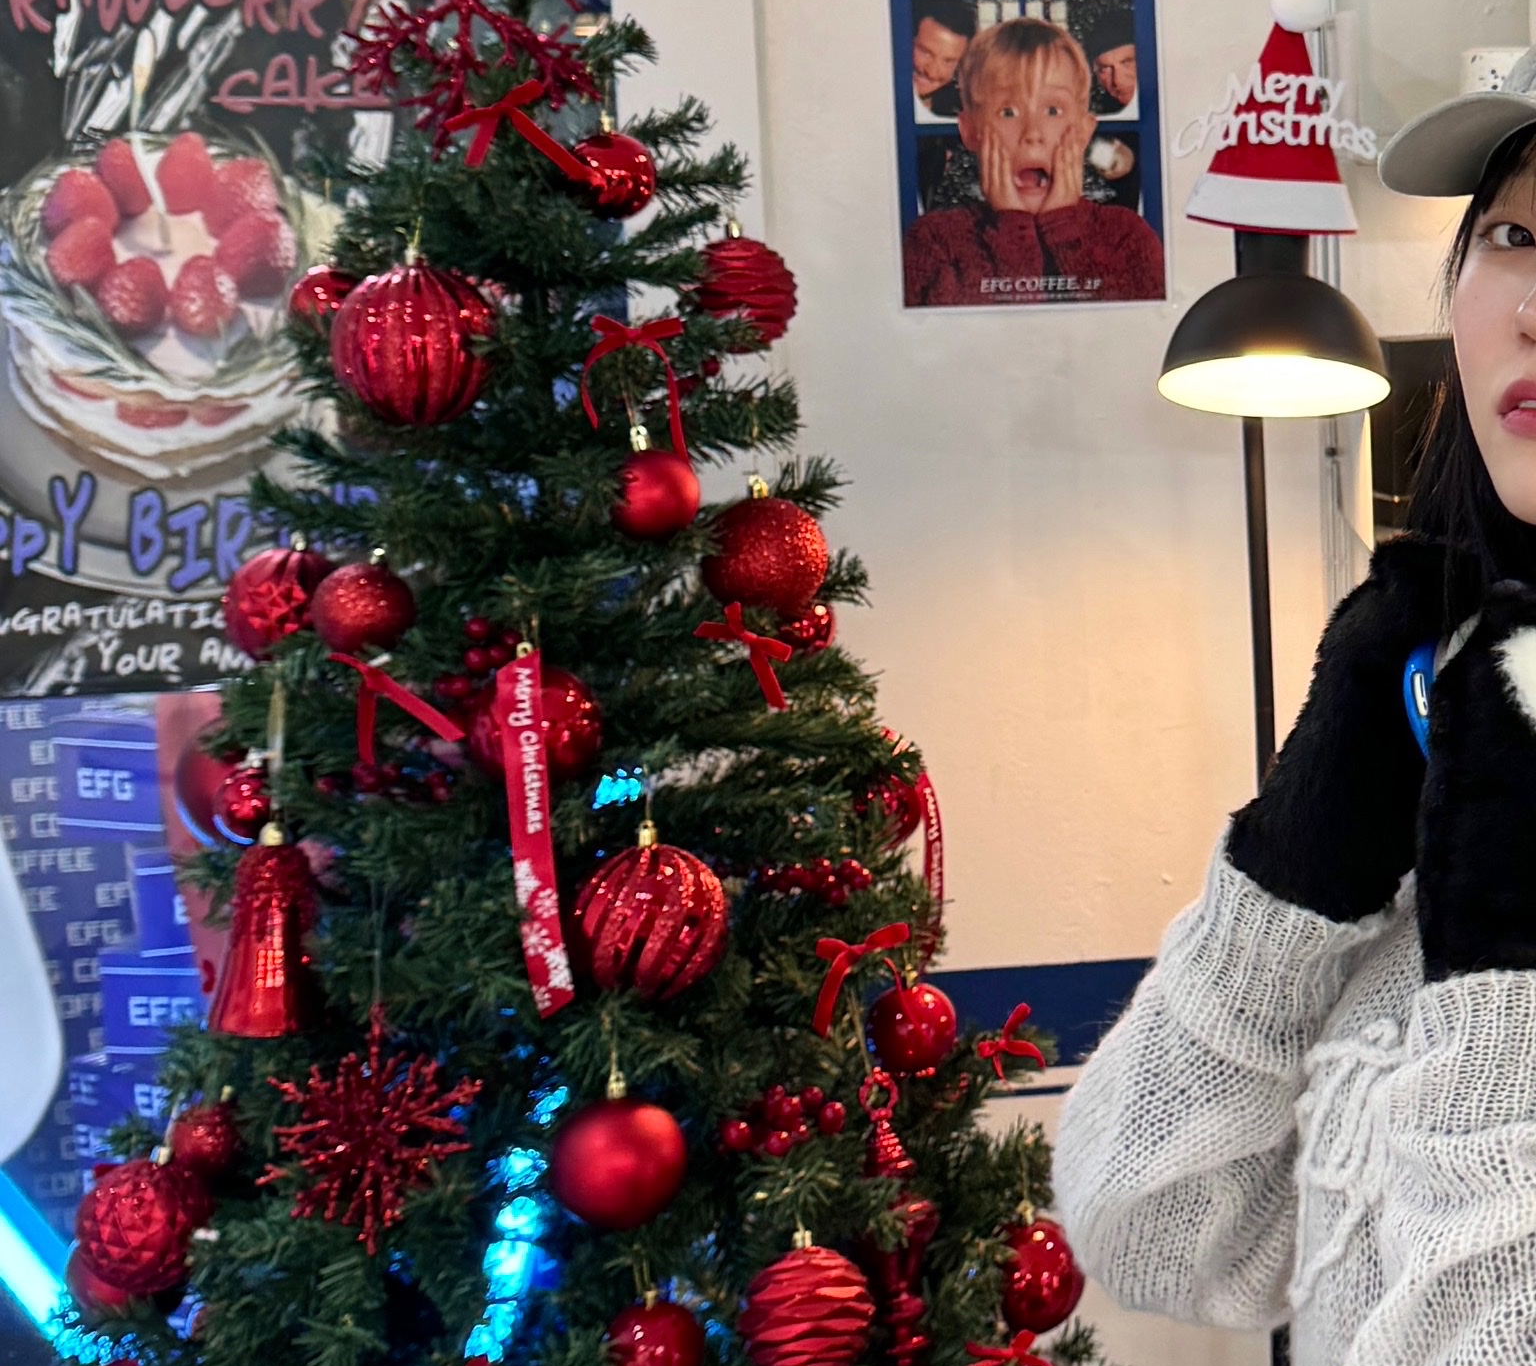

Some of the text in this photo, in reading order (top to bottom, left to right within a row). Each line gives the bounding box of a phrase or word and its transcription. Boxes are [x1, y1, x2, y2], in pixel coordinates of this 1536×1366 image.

[1216, 61, 1348, 117] Merry
[1171, 103, 1378, 161] Christmas
[980, 278, 1010, 293] EFG
[507, 666, 546, 835] Merry Christmas
[76, 767, 136, 801] EFG
